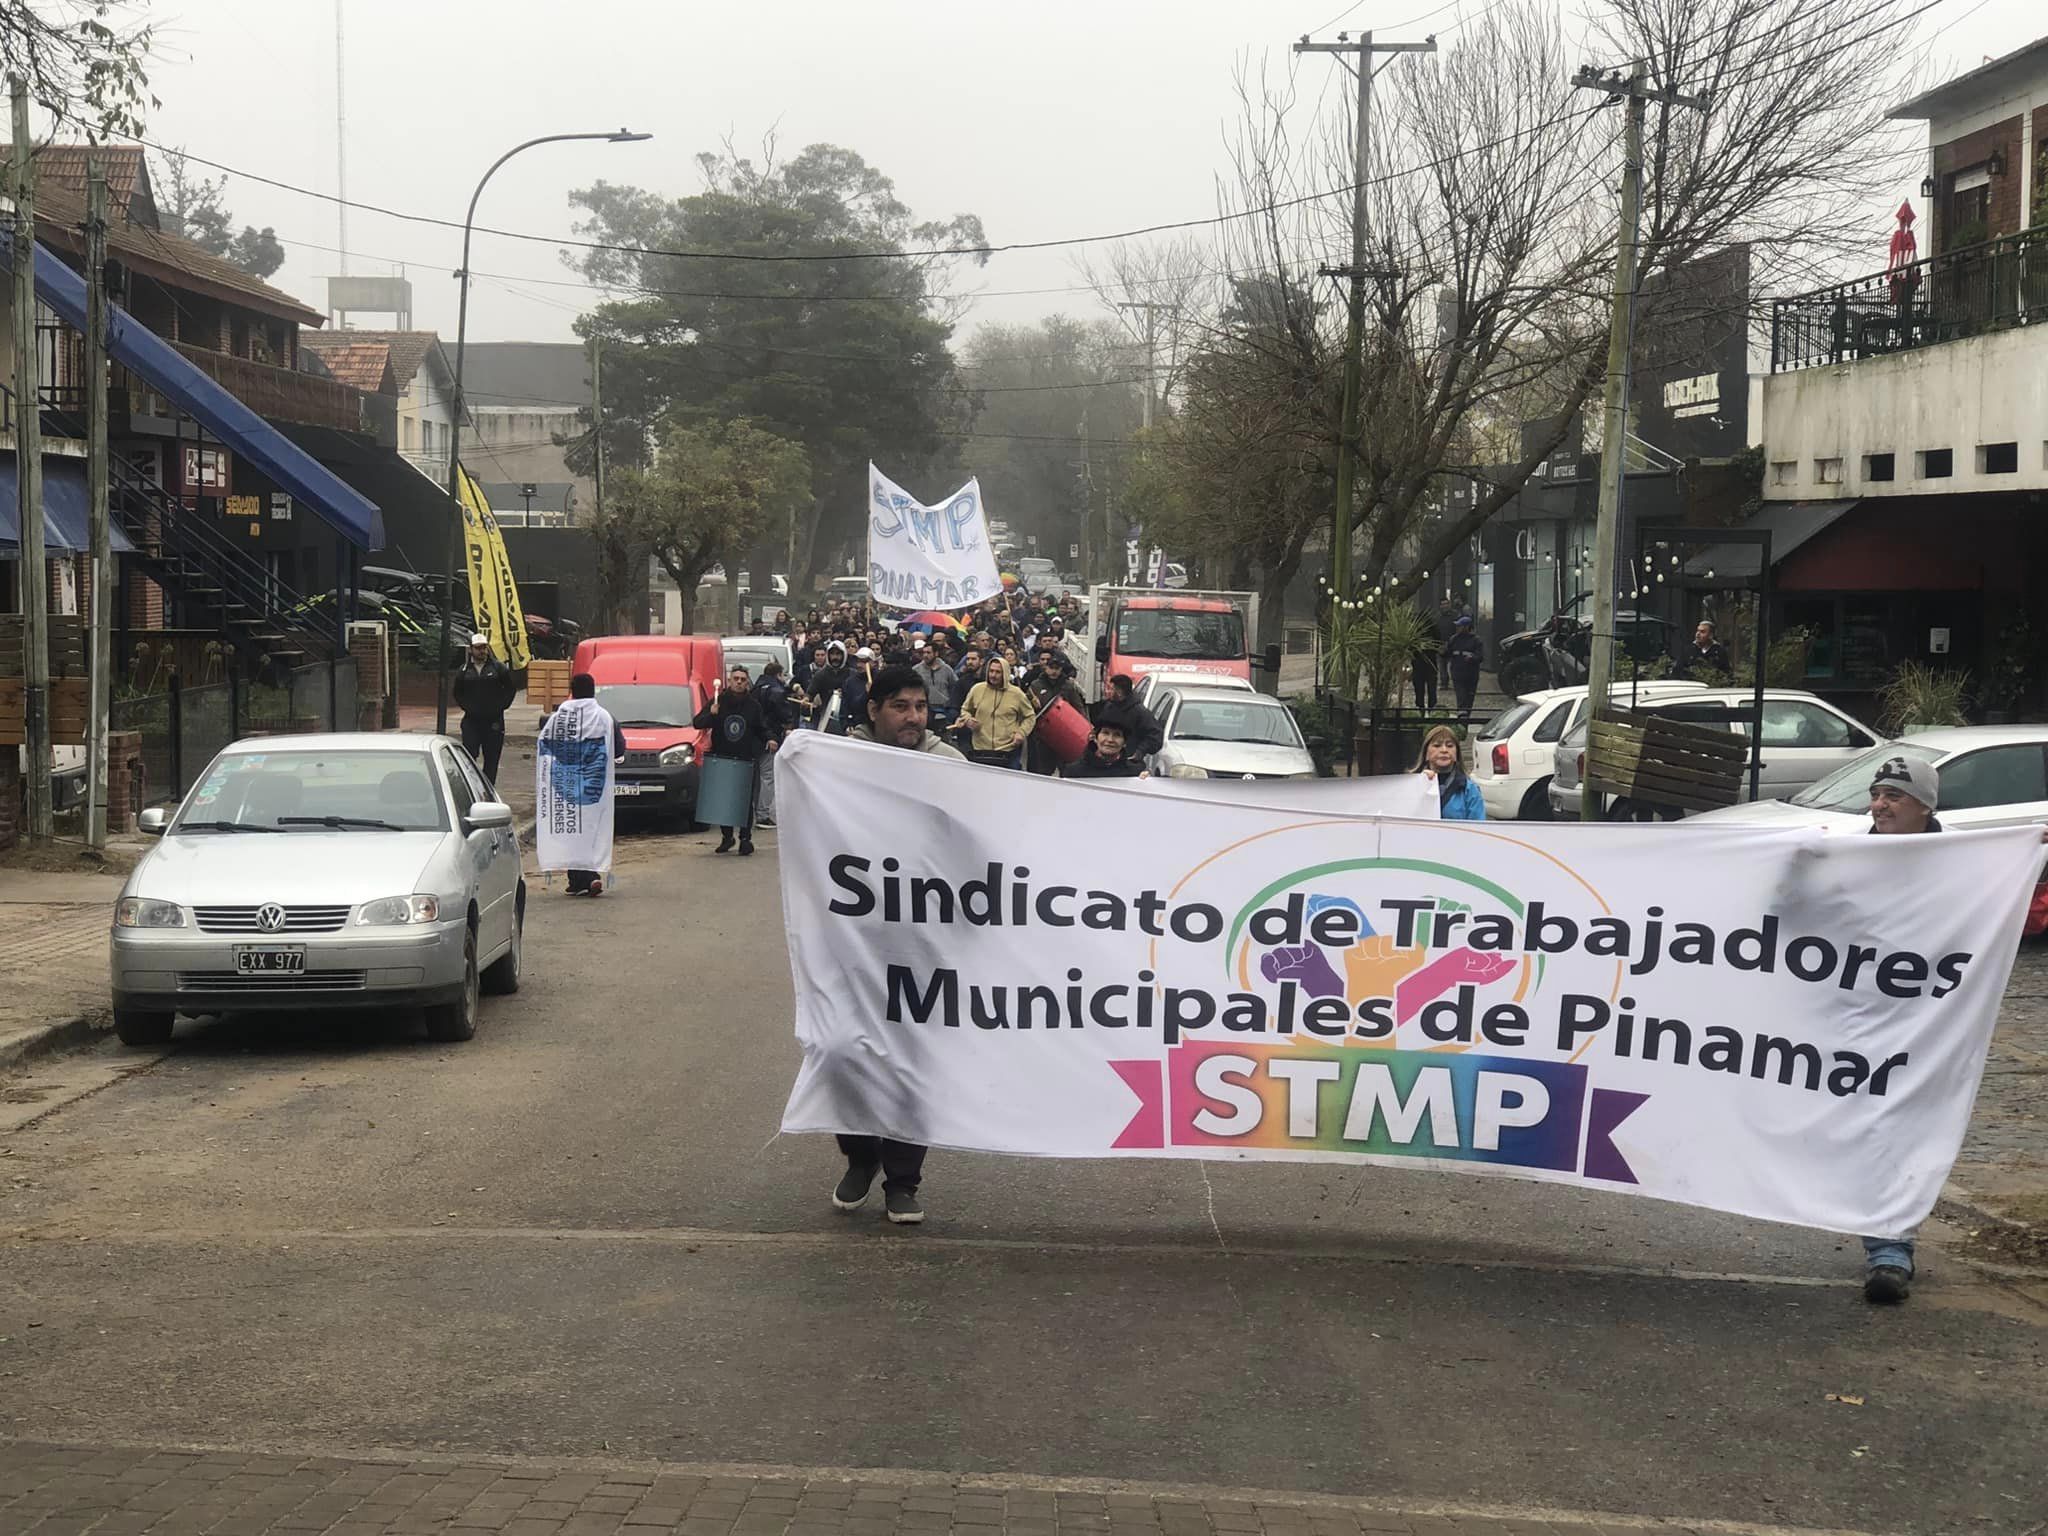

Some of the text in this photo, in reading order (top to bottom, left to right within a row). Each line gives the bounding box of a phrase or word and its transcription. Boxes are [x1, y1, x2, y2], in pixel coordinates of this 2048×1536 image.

[872, 481, 976, 554] STMP
[871, 562, 979, 605] PINAMAR
[565, 779, 577, 835] SINDICATOS
[240, 953, 302, 969] EXX 977
[828, 853, 1973, 1000] Sindicato de Trabajadores
[885, 963, 1909, 1098] Municipales de Pinamar
[1191, 1054, 1551, 1152] STMP
